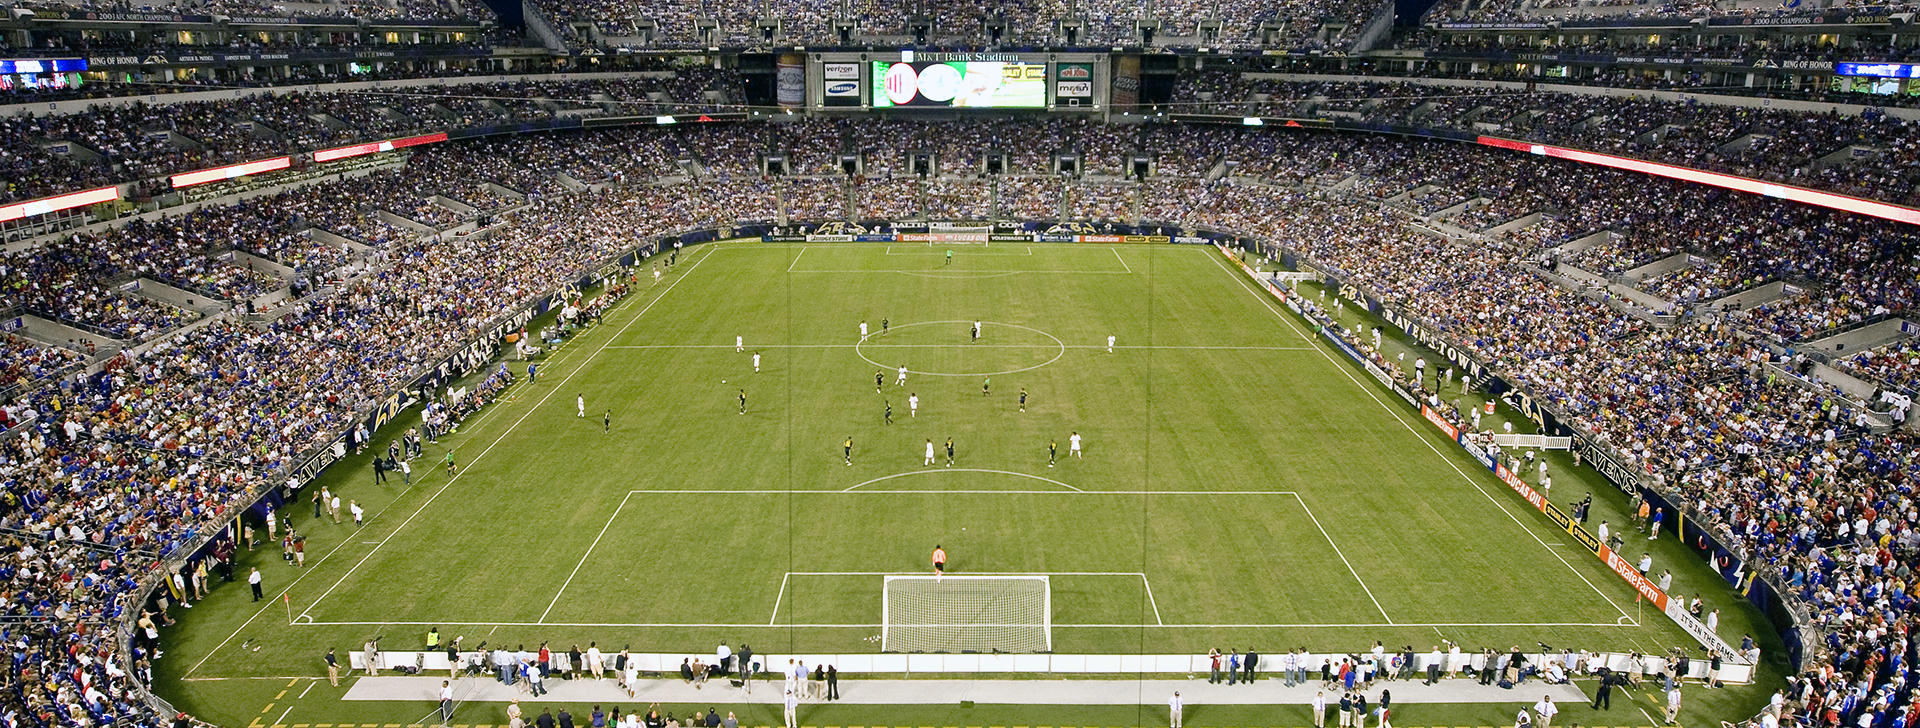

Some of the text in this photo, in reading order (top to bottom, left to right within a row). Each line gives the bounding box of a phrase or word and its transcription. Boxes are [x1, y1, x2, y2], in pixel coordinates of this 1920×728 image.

[144, 14, 173, 22] CHAMPIONS
[89, 56, 139, 65] RING OF HONOR
[917, 52, 1019, 62] M&T Bank Stadium
[1783, 60, 1833, 69] RING OF HONOR
[1384, 308, 1482, 380] RAVENSTOWN
[1506, 474, 1543, 509] LUCAS OIL
[1546, 504, 1570, 528] STANLEY
[1573, 525, 1598, 551] STANLEY
[1616, 560, 1659, 603] StateFarm
[1680, 613, 1735, 663] IT'S IN THE GAME
